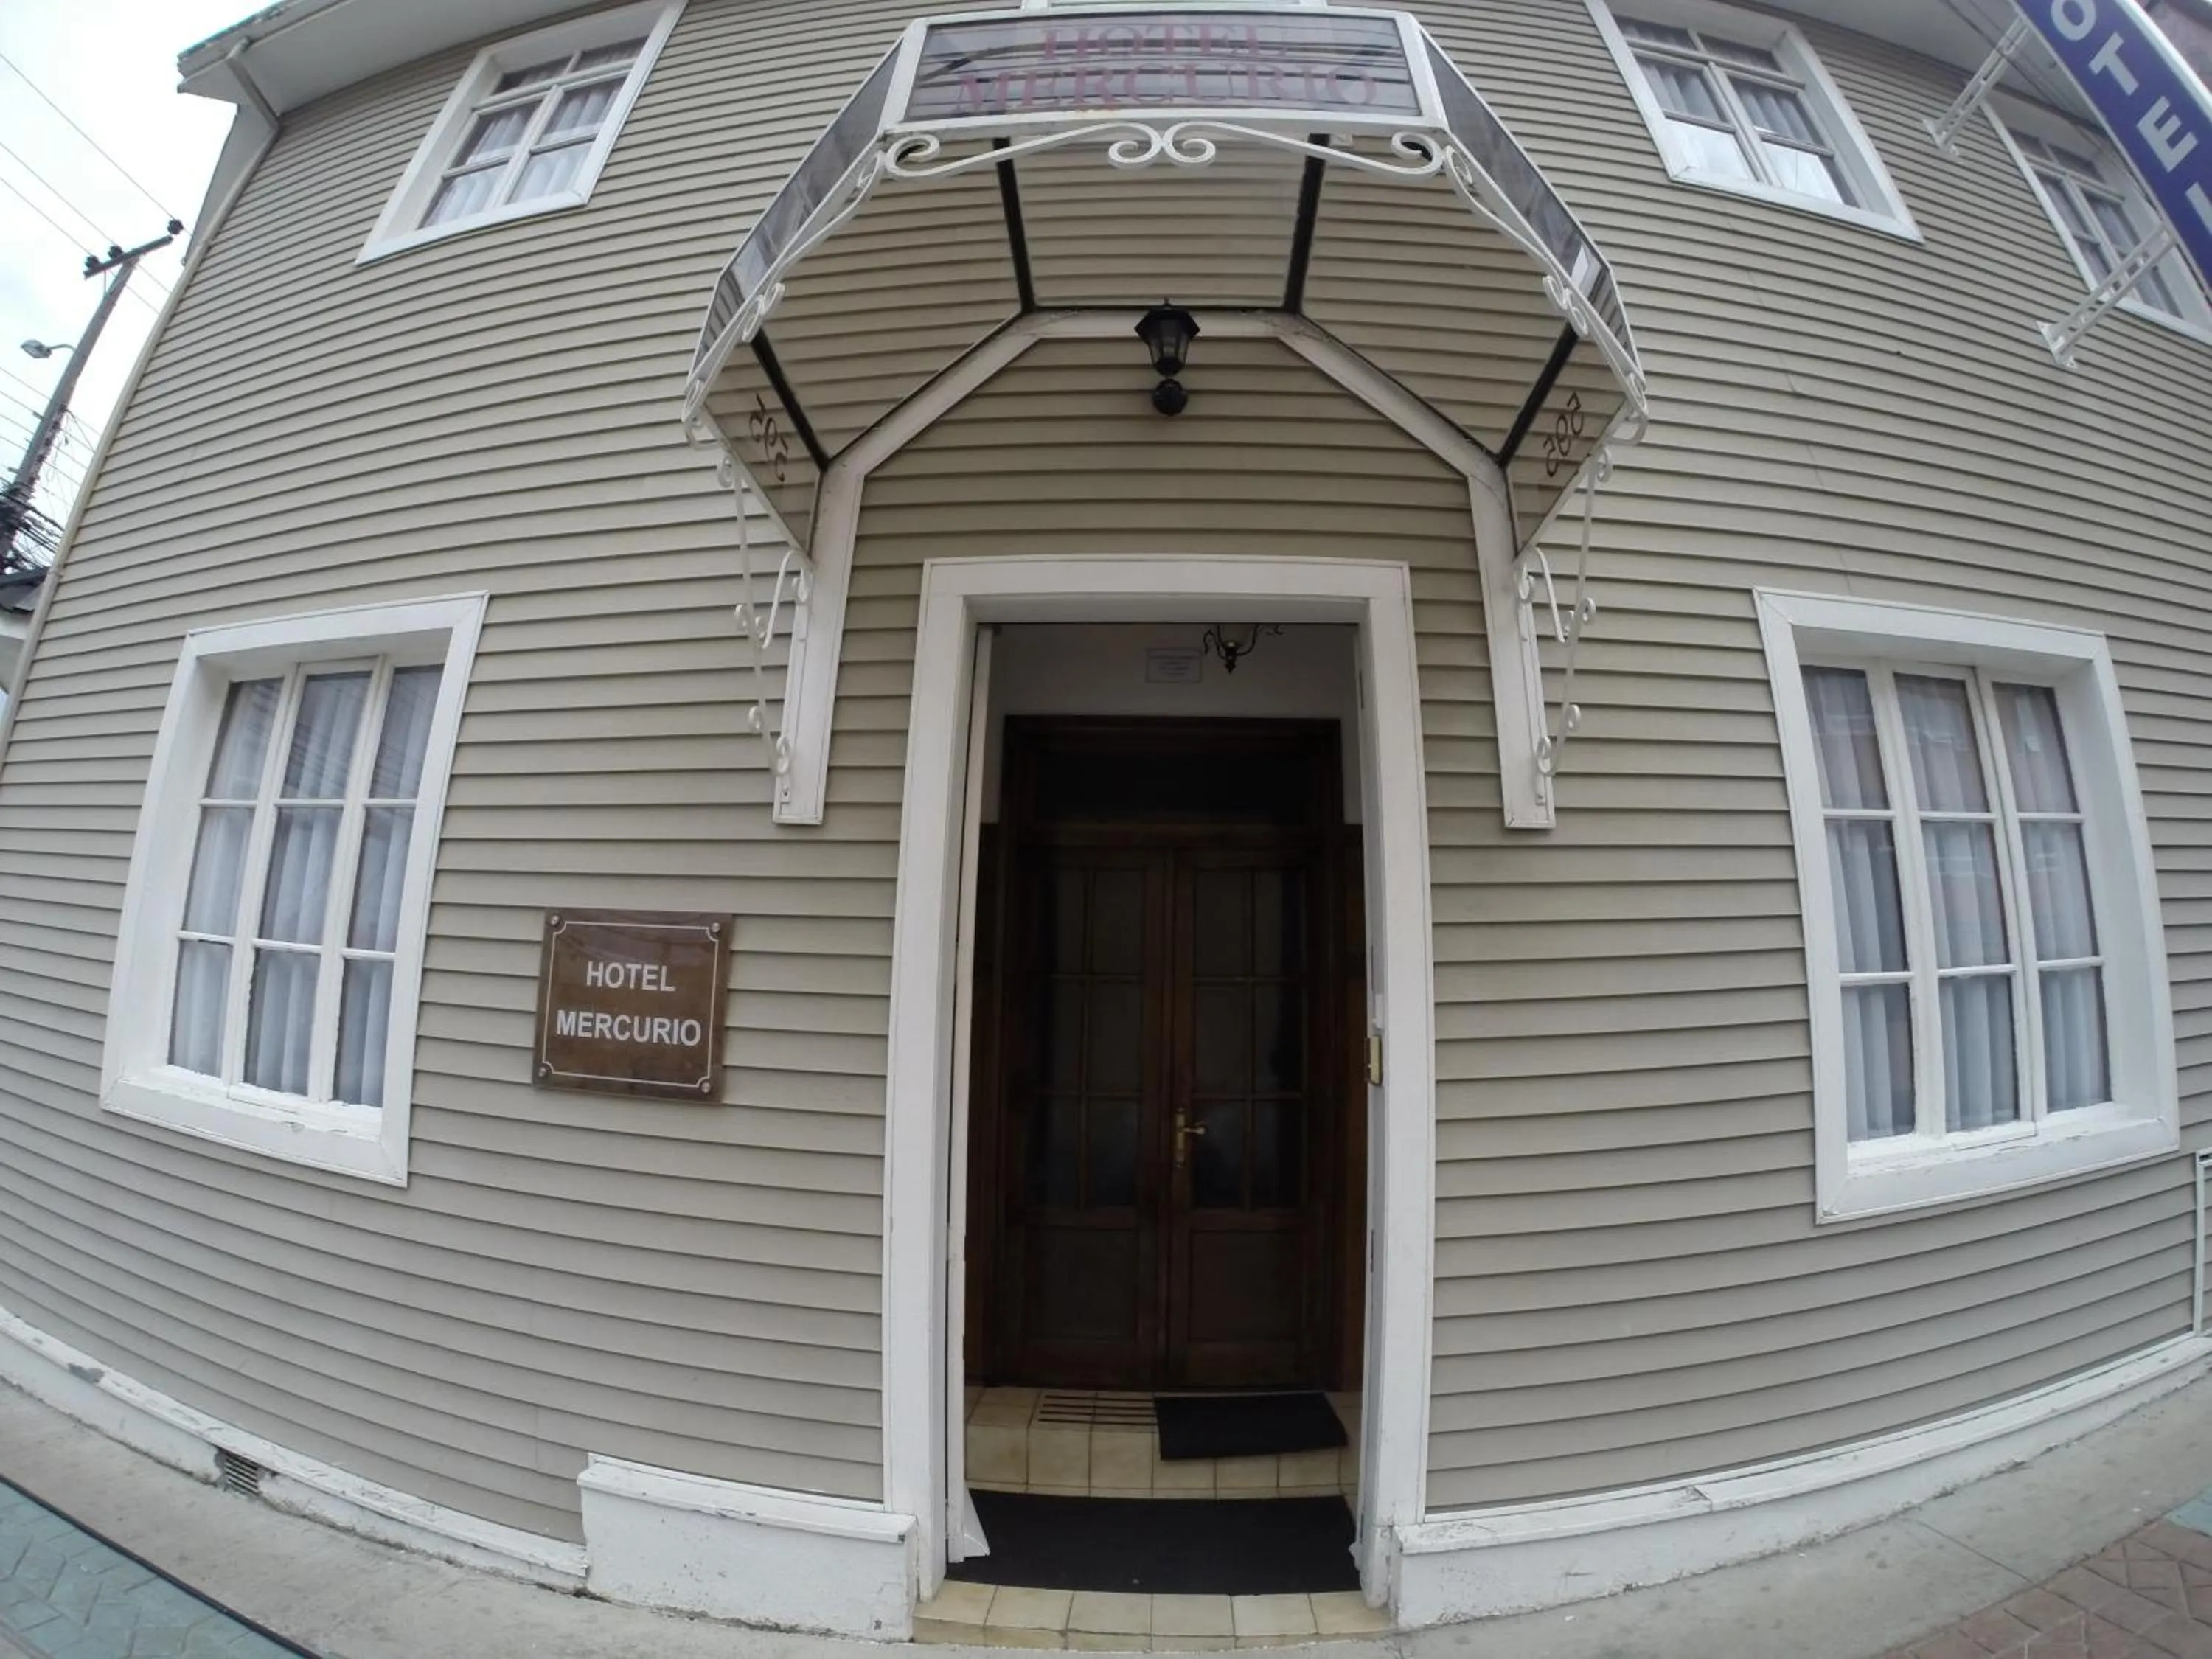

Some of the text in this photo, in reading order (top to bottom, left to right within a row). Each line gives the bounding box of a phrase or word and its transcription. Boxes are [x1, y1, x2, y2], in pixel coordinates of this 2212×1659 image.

[1039, 23, 1288, 61] HOTEL
[949, 62, 1377, 112] MERCURIO
[586, 961, 675, 992] HOTEL
[556, 1009, 701, 1046] MERCURIO
